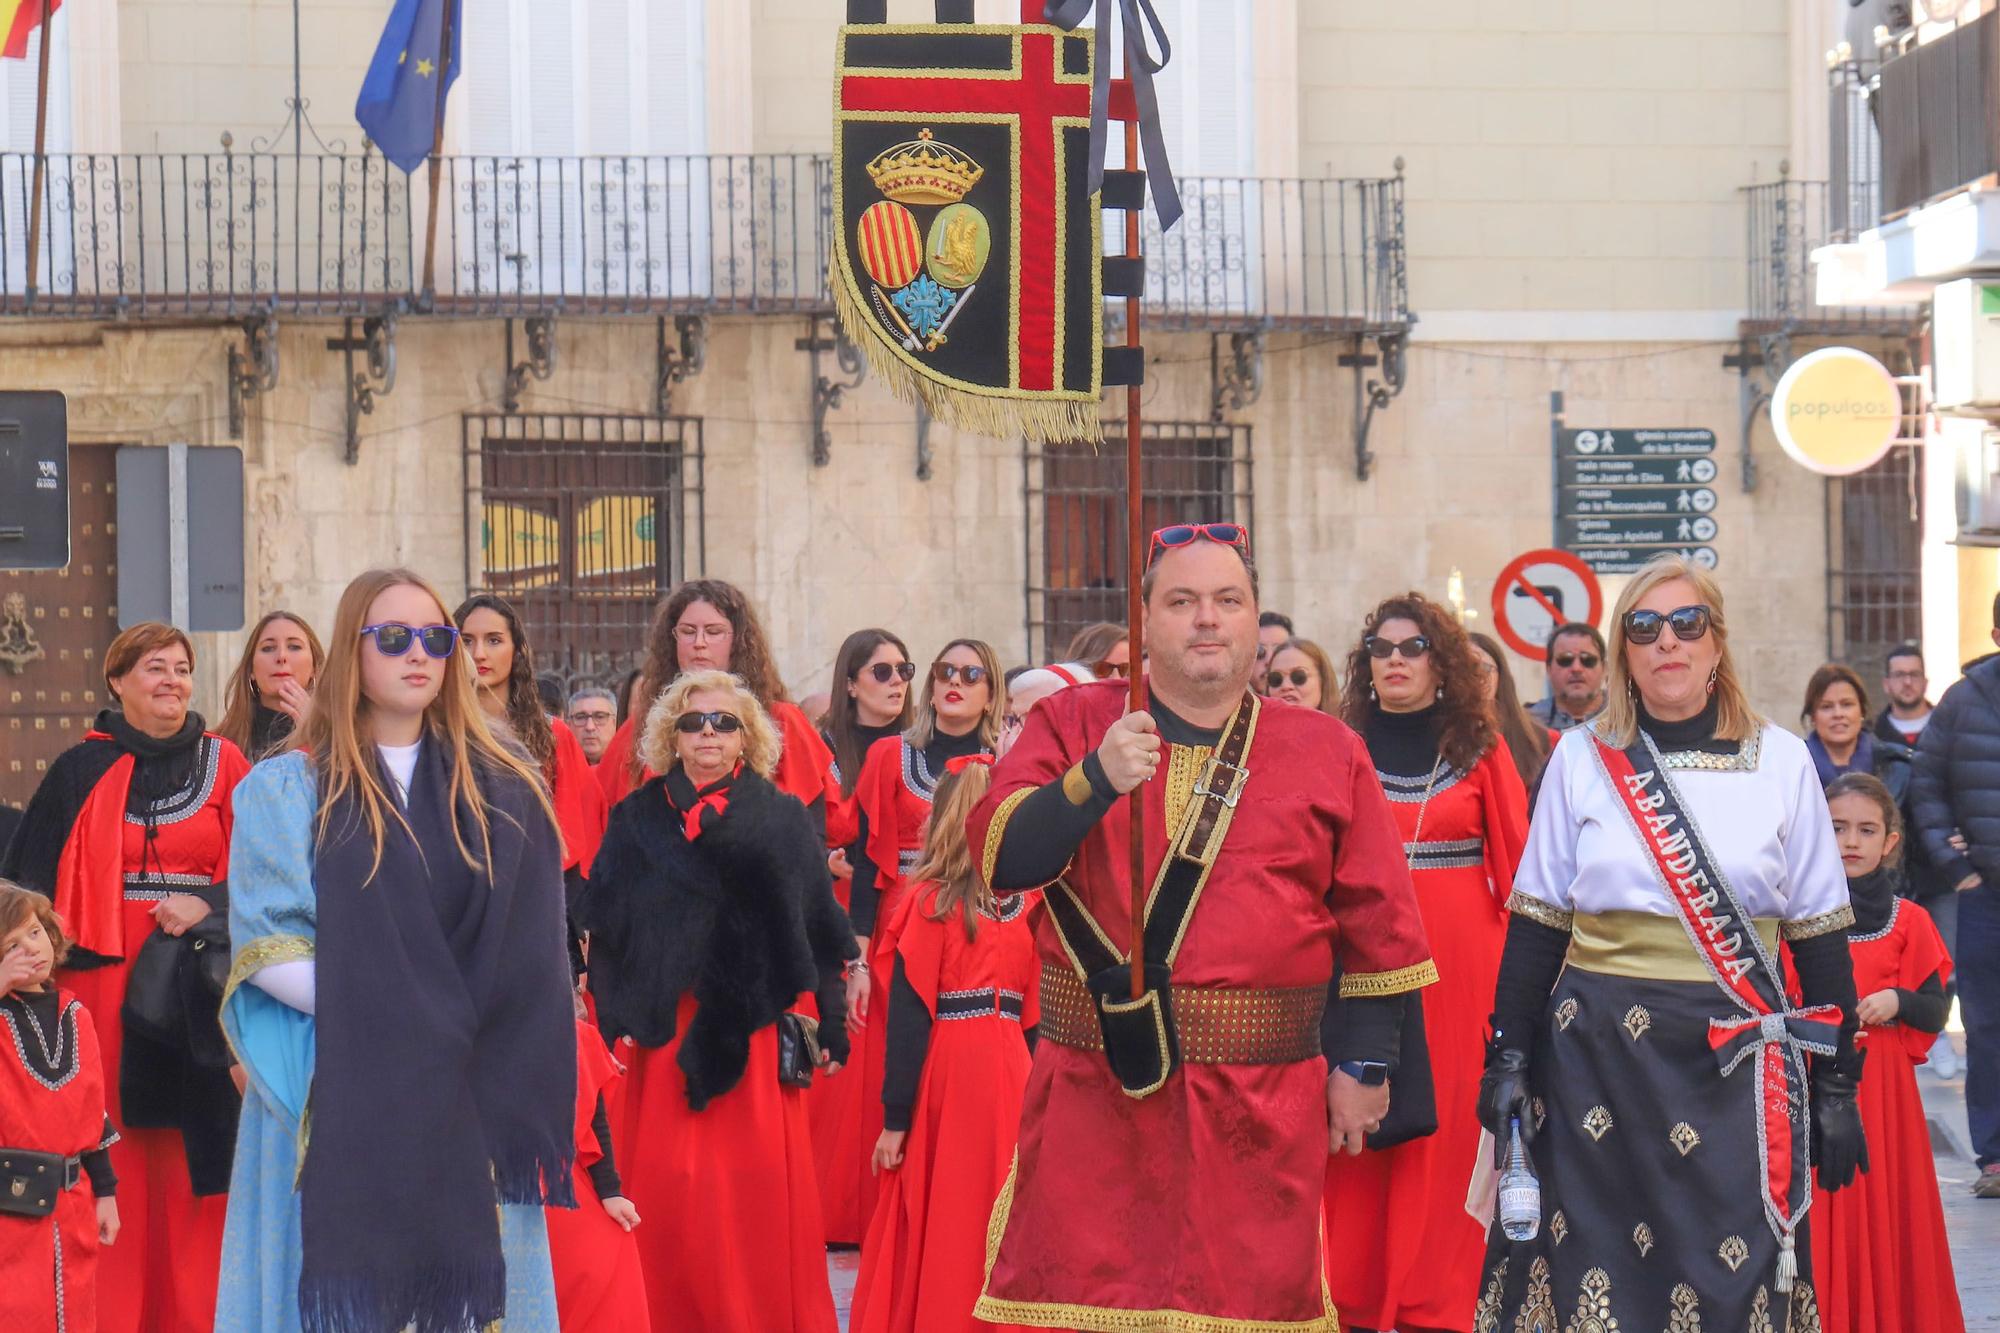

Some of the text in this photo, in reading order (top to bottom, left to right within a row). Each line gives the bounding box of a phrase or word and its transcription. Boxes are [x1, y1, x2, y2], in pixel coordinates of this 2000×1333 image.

[1642, 443, 1656, 453] de
[1599, 462, 1634, 470] museo
[1576, 472, 1664, 483] San Juan de Dios
[1577, 490, 1612, 499] museo
[1577, 501, 1667, 512] de la Reconquista
[1578, 531, 1663, 544] Santiago Apóstol
[1580, 550, 1630, 559] santuario
[1624, 769, 1756, 985] ABANDERADA
[1768, 1045, 1792, 1062] Elisa
[1771, 1099, 1798, 1124] 2022
